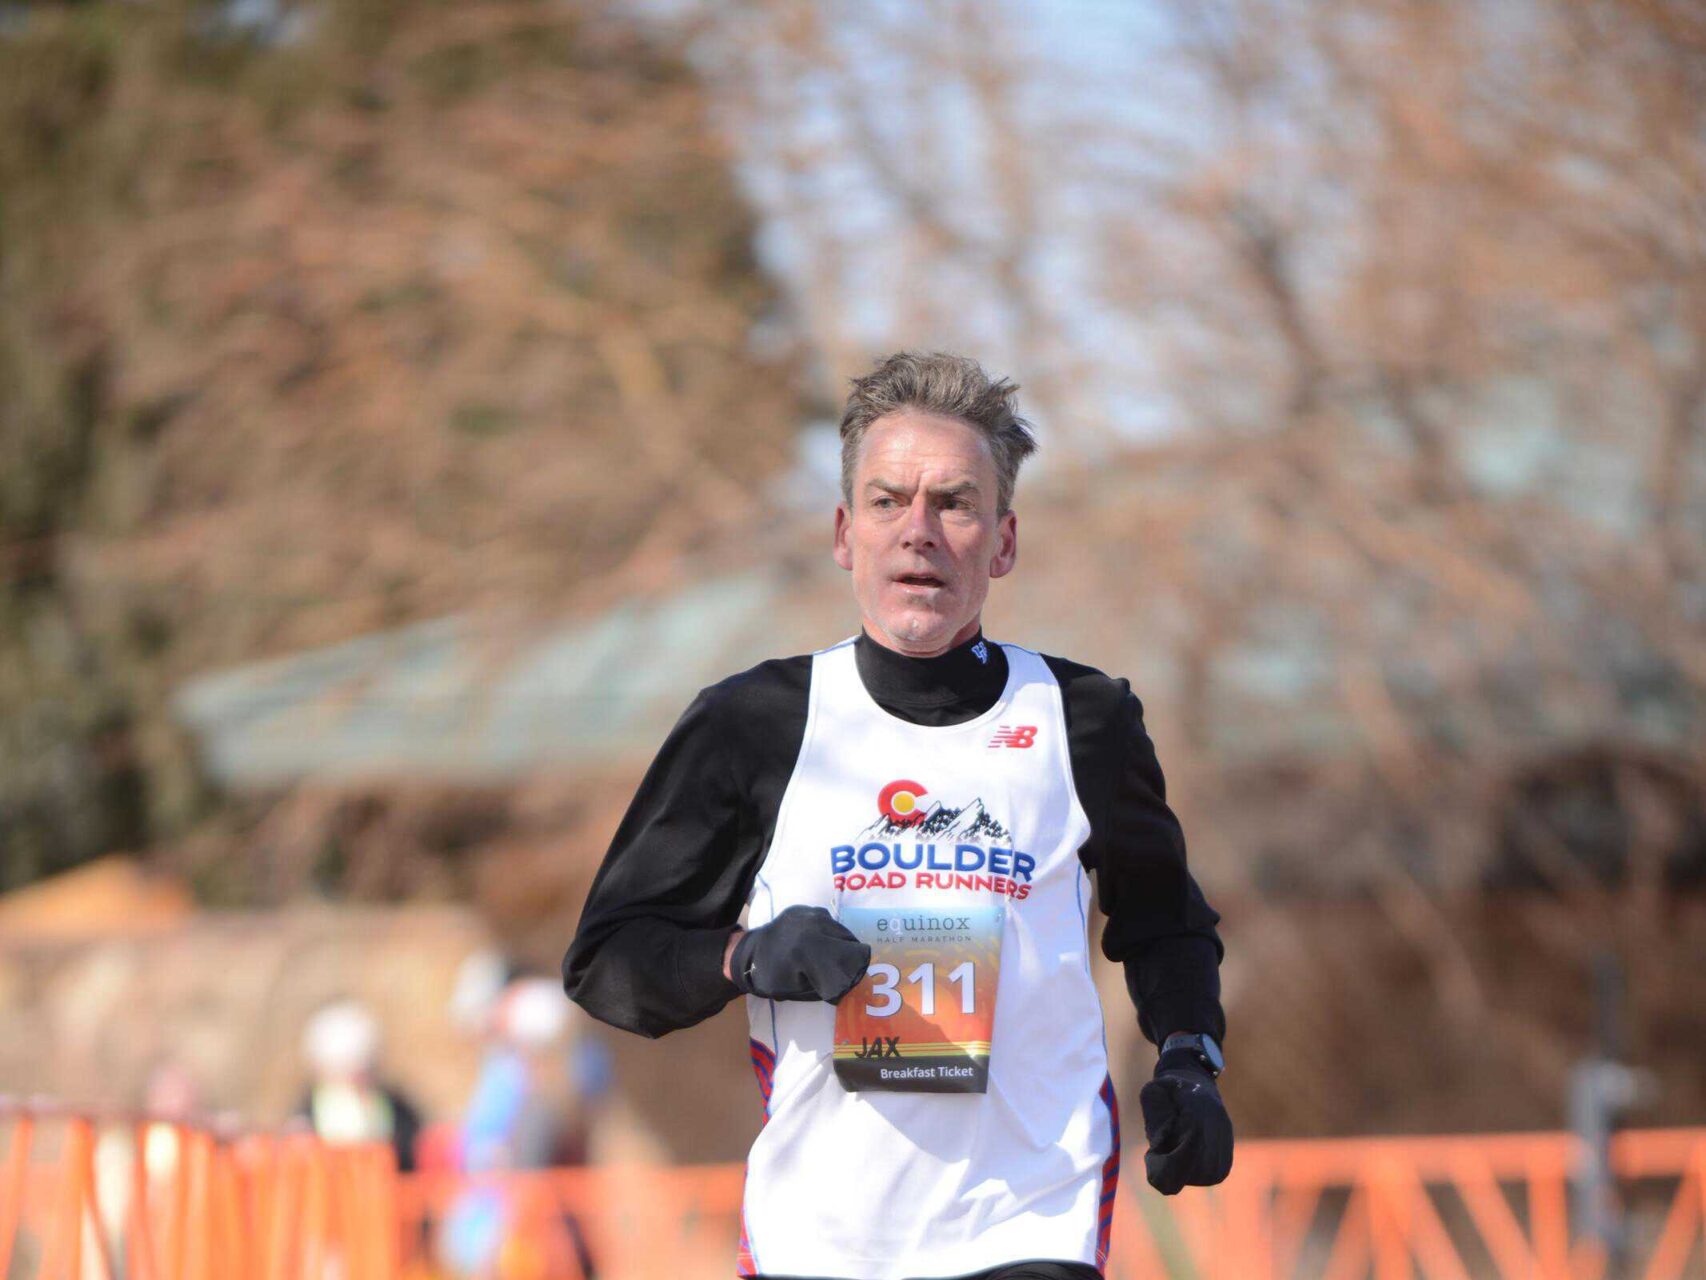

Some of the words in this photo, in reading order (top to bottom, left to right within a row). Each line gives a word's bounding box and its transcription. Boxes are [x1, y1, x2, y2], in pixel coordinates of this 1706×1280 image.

[830, 842, 1036, 882] BOULDER
[834, 872, 906, 892] ROAD
[915, 871, 1032, 900] RUNNERS
[876, 914, 971, 935] equinox
[876, 936, 905, 944] HALF
[911, 935, 972, 943] MARATHON
[865, 961, 976, 1017] 311
[854, 1036, 901, 1058] JAX
[880, 1067, 936, 1079] Breakfast
[939, 1066, 974, 1078] Ticket
